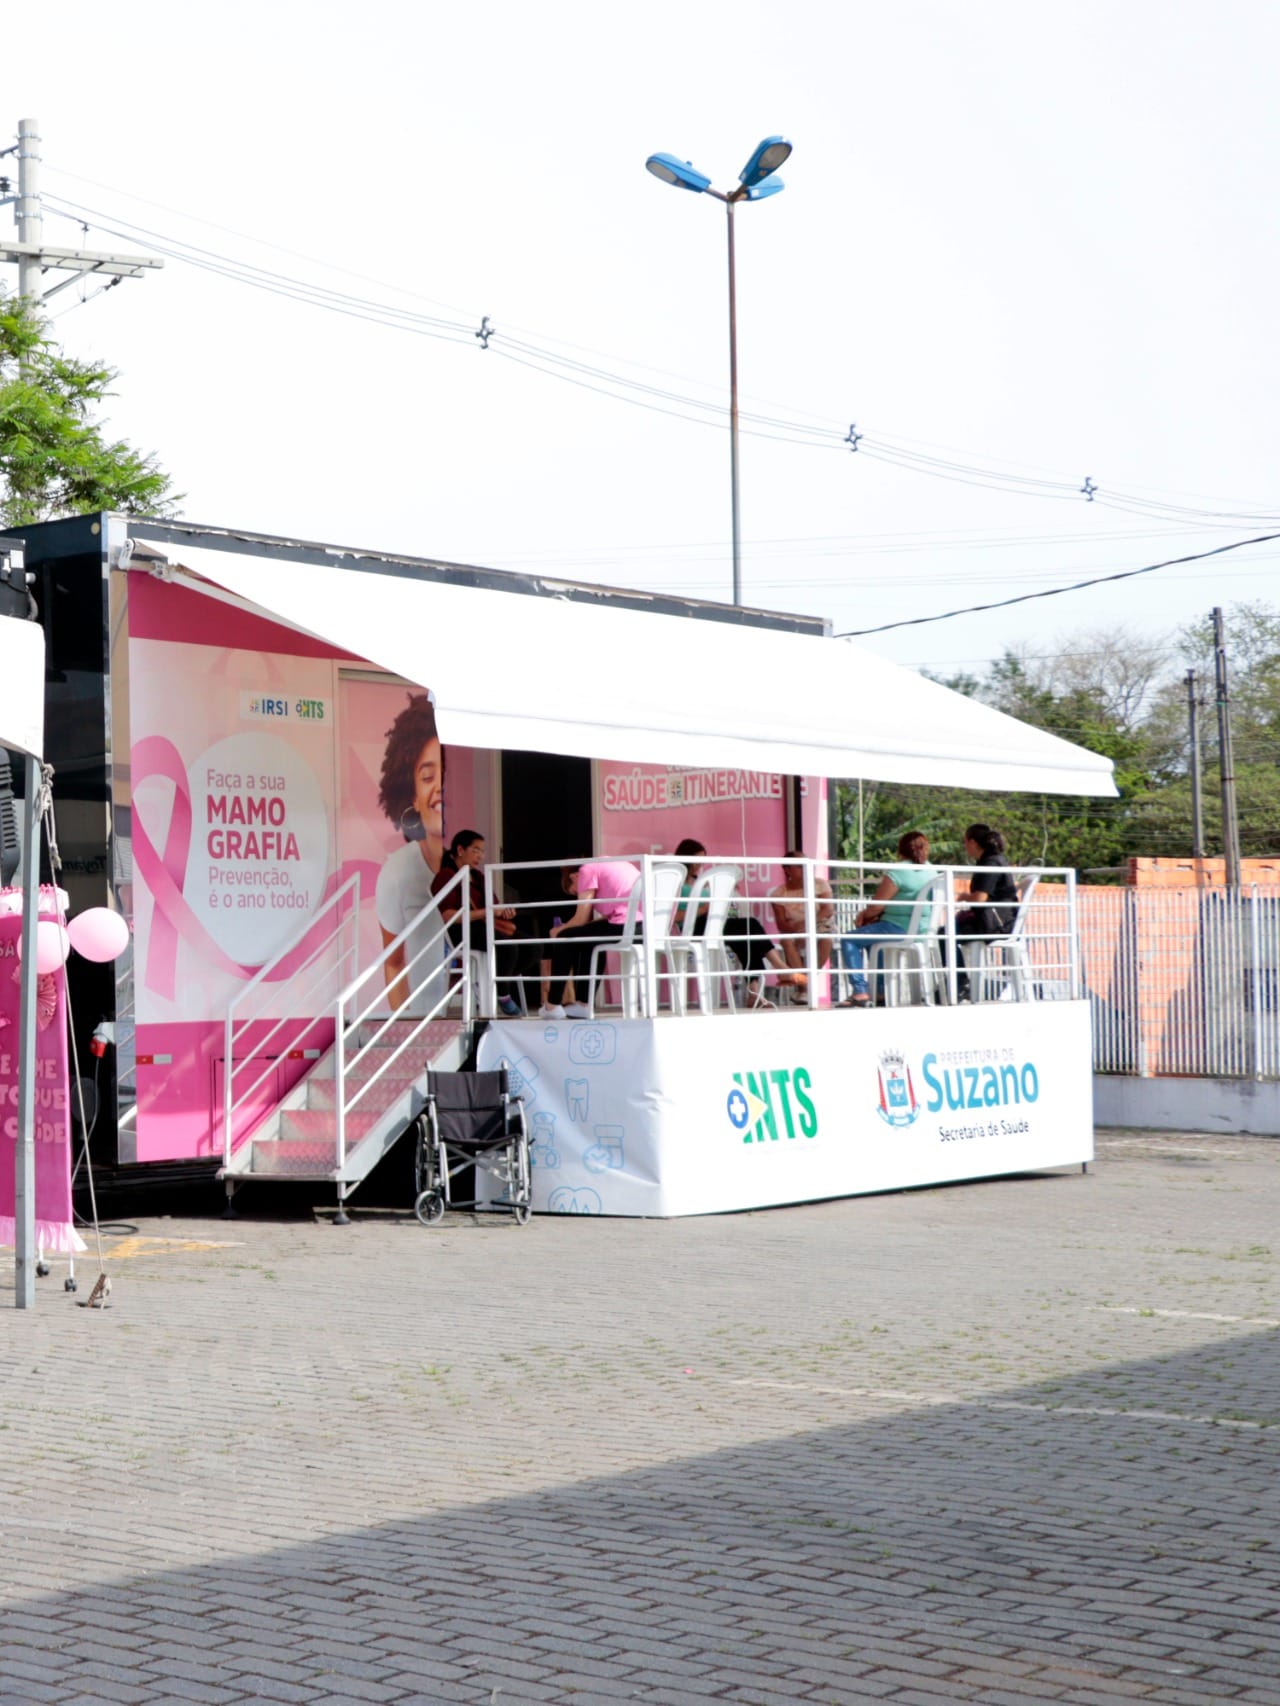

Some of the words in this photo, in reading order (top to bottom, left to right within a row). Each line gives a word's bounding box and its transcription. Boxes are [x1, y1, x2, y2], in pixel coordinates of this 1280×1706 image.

[262, 699, 288, 716] IRSI
[207, 769, 241, 792] Faça
[246, 775, 255, 789] a
[260, 776, 285, 790] sua
[606, 770, 666, 807] SAÚDE
[683, 773, 781, 801] ITINERANTE
[207, 794, 286, 826] MAMO
[207, 829, 300, 861] GRAFIA
[208, 866, 293, 889] Prevenção,
[208, 889, 218, 908] é
[223, 893, 233, 908] o
[237, 893, 266, 908] ano
[271, 890, 310, 908] todo!
[922, 1052, 1039, 1113] Suzano
[938, 1126, 986, 1142] Secretaria
[988, 1121, 999, 1137] de
